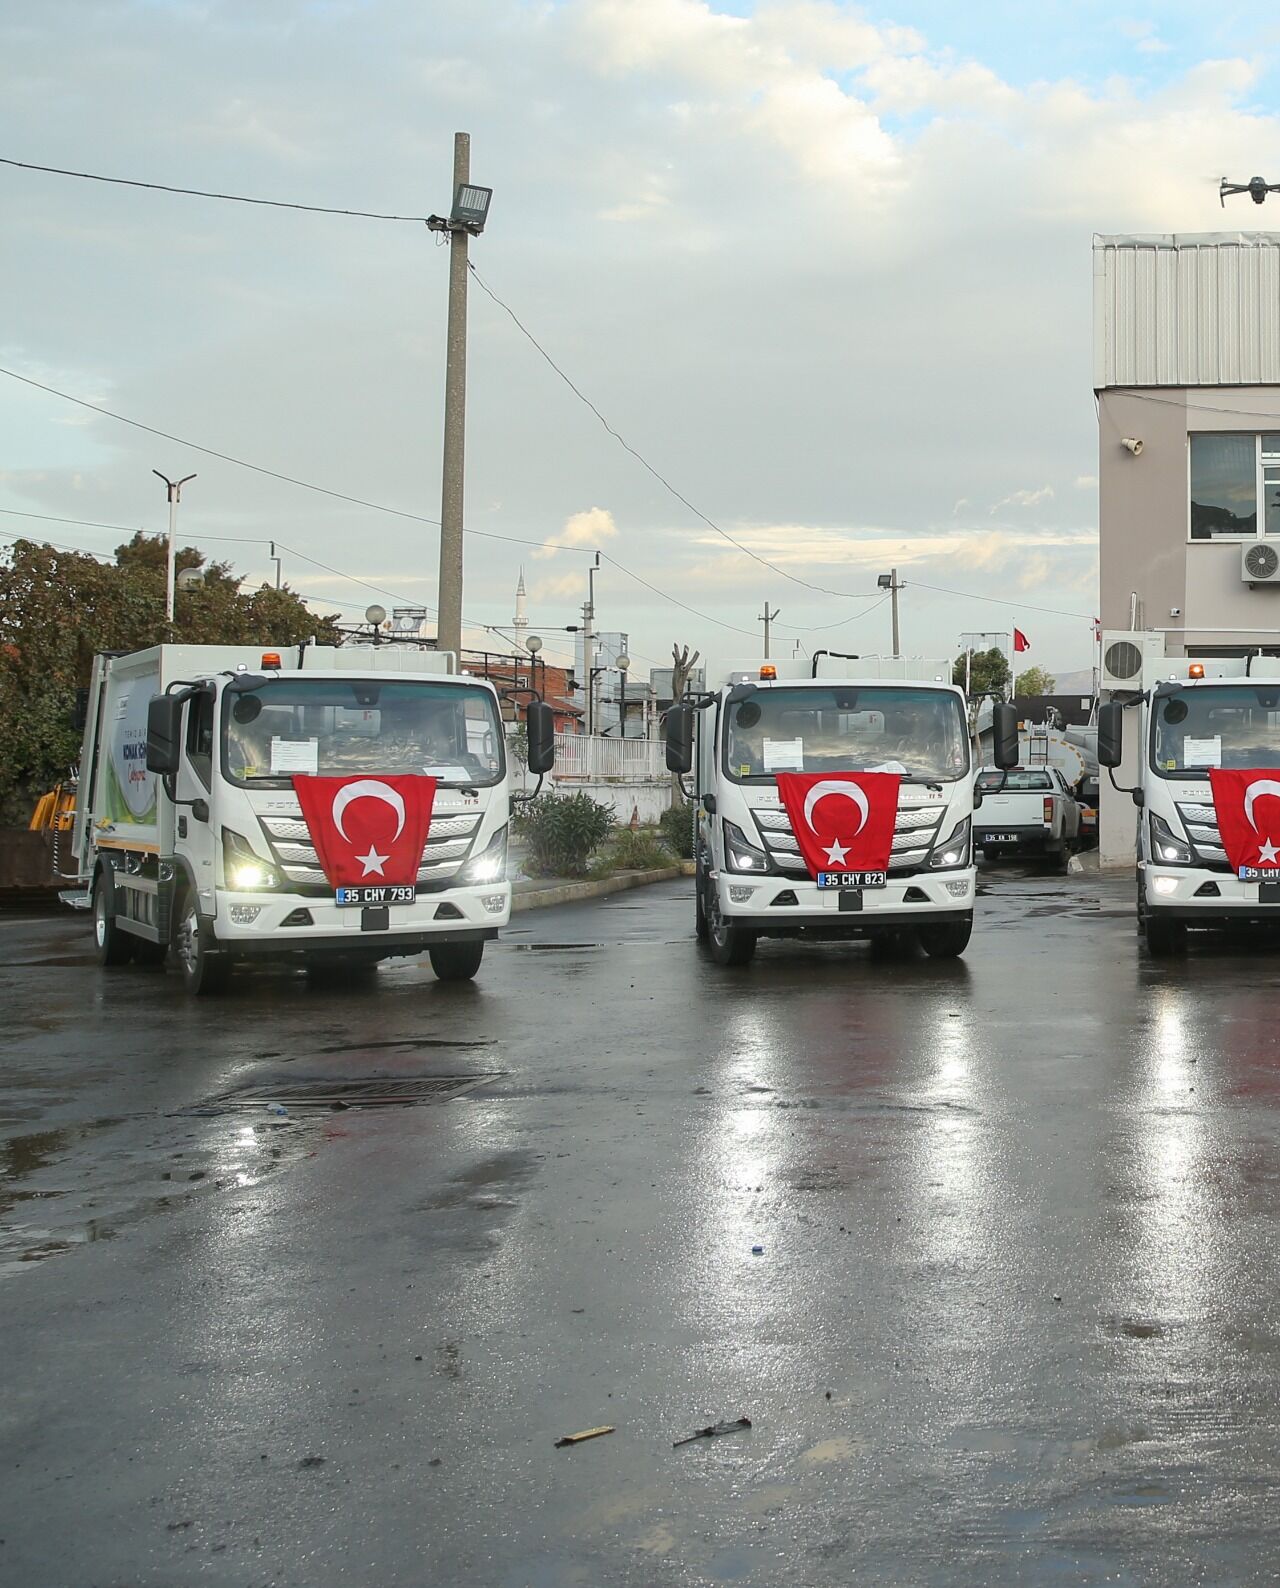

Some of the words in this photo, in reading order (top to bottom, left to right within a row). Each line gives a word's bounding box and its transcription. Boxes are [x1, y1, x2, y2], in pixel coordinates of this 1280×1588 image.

[1246, 867, 1258, 877] 35
[1262, 868, 1279, 877] CHY
[826, 874, 838, 885] 35
[842, 873, 861, 885] CHY
[865, 873, 884, 884] 823
[344, 889, 359, 902] 35
[364, 889, 385, 901] CHY
[391, 887, 412, 900] 793
